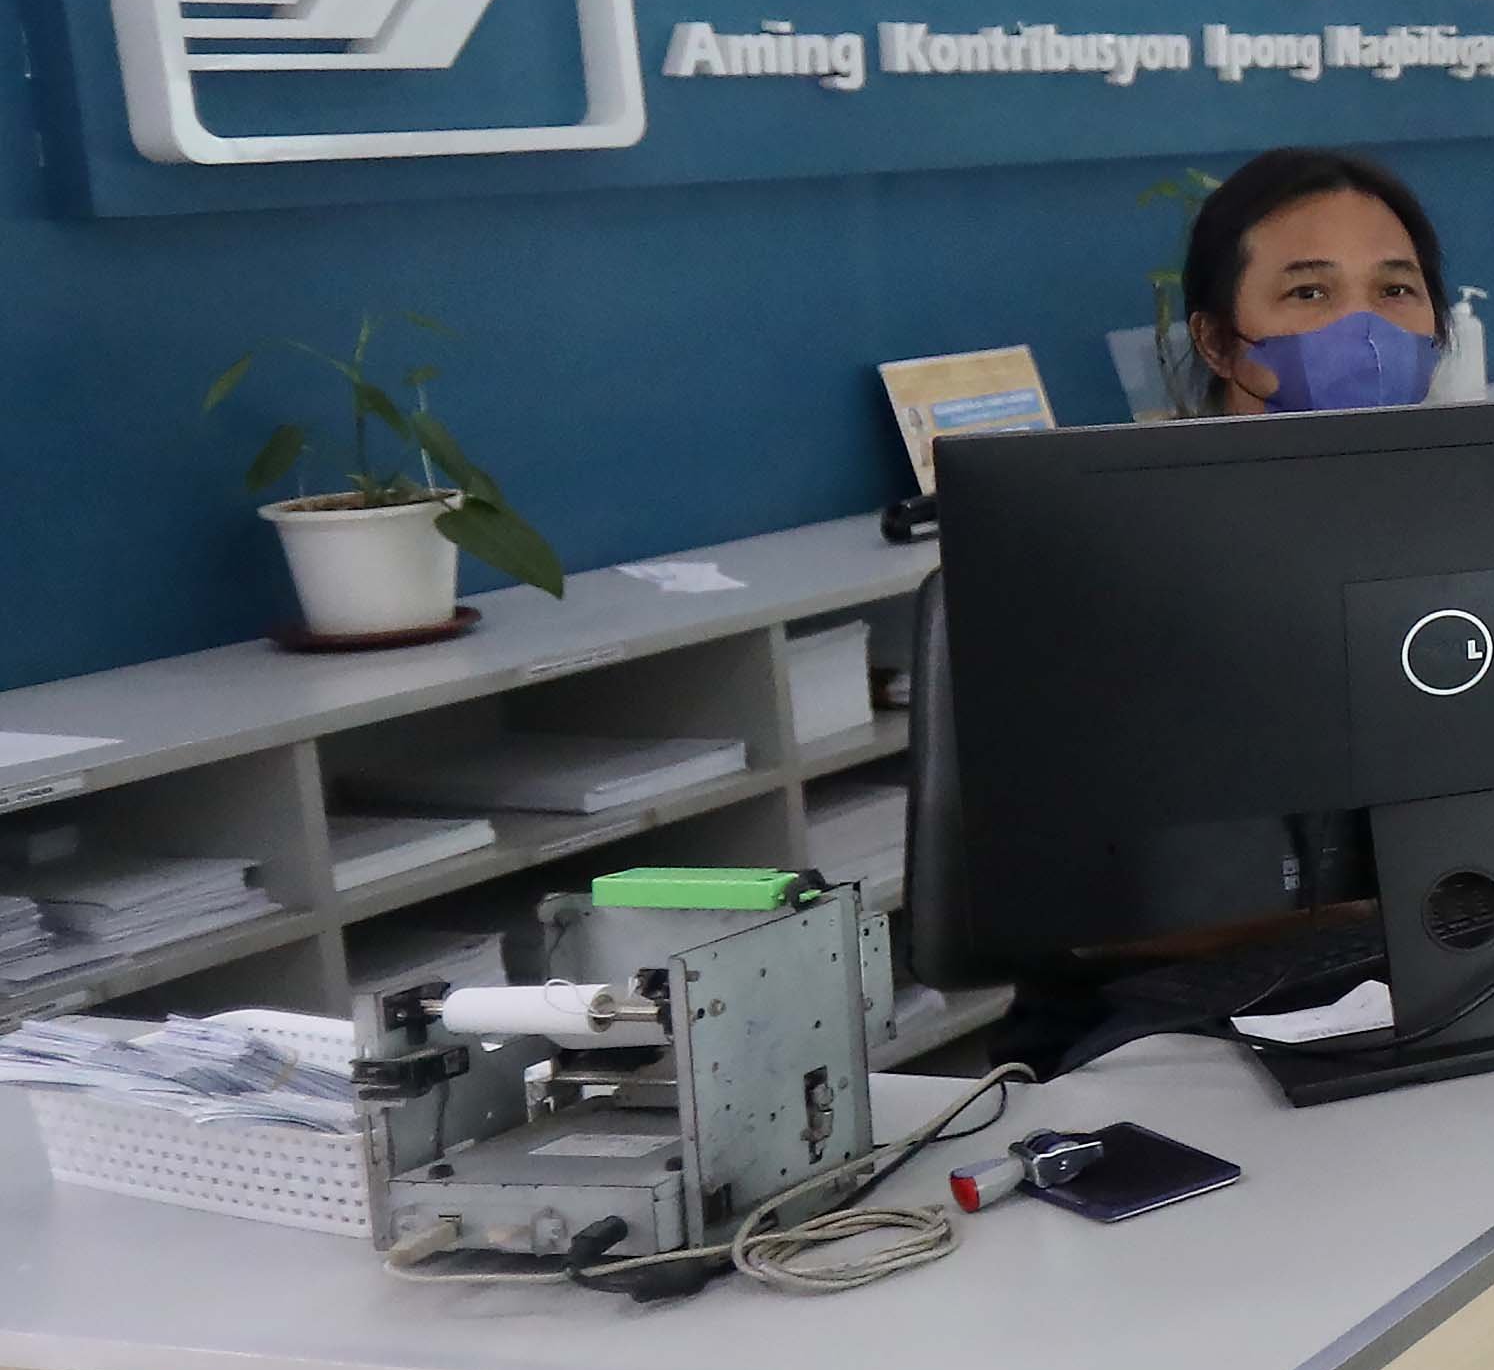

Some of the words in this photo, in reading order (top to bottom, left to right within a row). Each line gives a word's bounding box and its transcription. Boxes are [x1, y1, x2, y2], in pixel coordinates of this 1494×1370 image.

[662, 19, 866, 92] Aming
[876, 20, 1191, 87] Kontribusyon
[1202, 23, 1322, 83] Ipong
